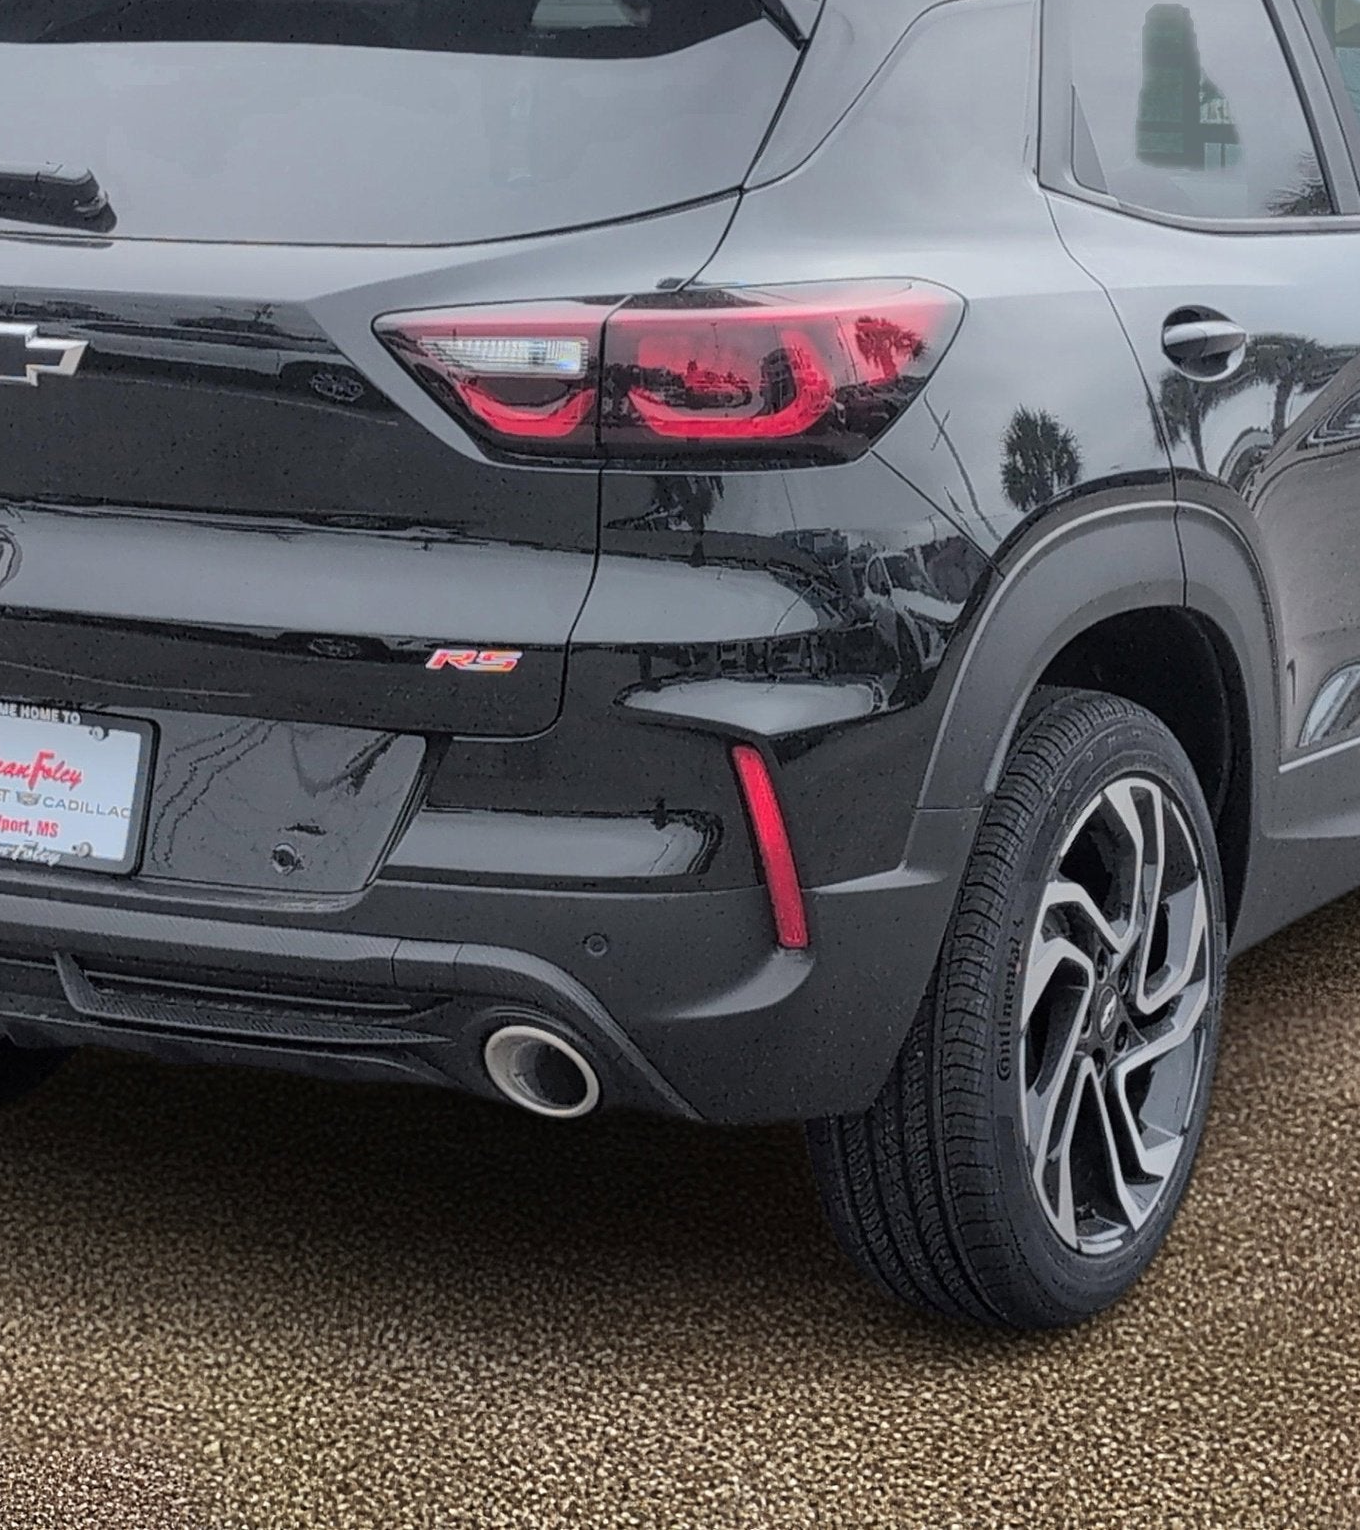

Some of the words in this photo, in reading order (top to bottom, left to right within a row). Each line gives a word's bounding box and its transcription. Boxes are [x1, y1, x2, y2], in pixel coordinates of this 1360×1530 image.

[425, 648, 524, 672] RS
[20, 703, 59, 722] HOME
[62, 710, 81, 725] TO
[42, 795, 133, 819] CADILLAC
[36, 820, 59, 838] MS
